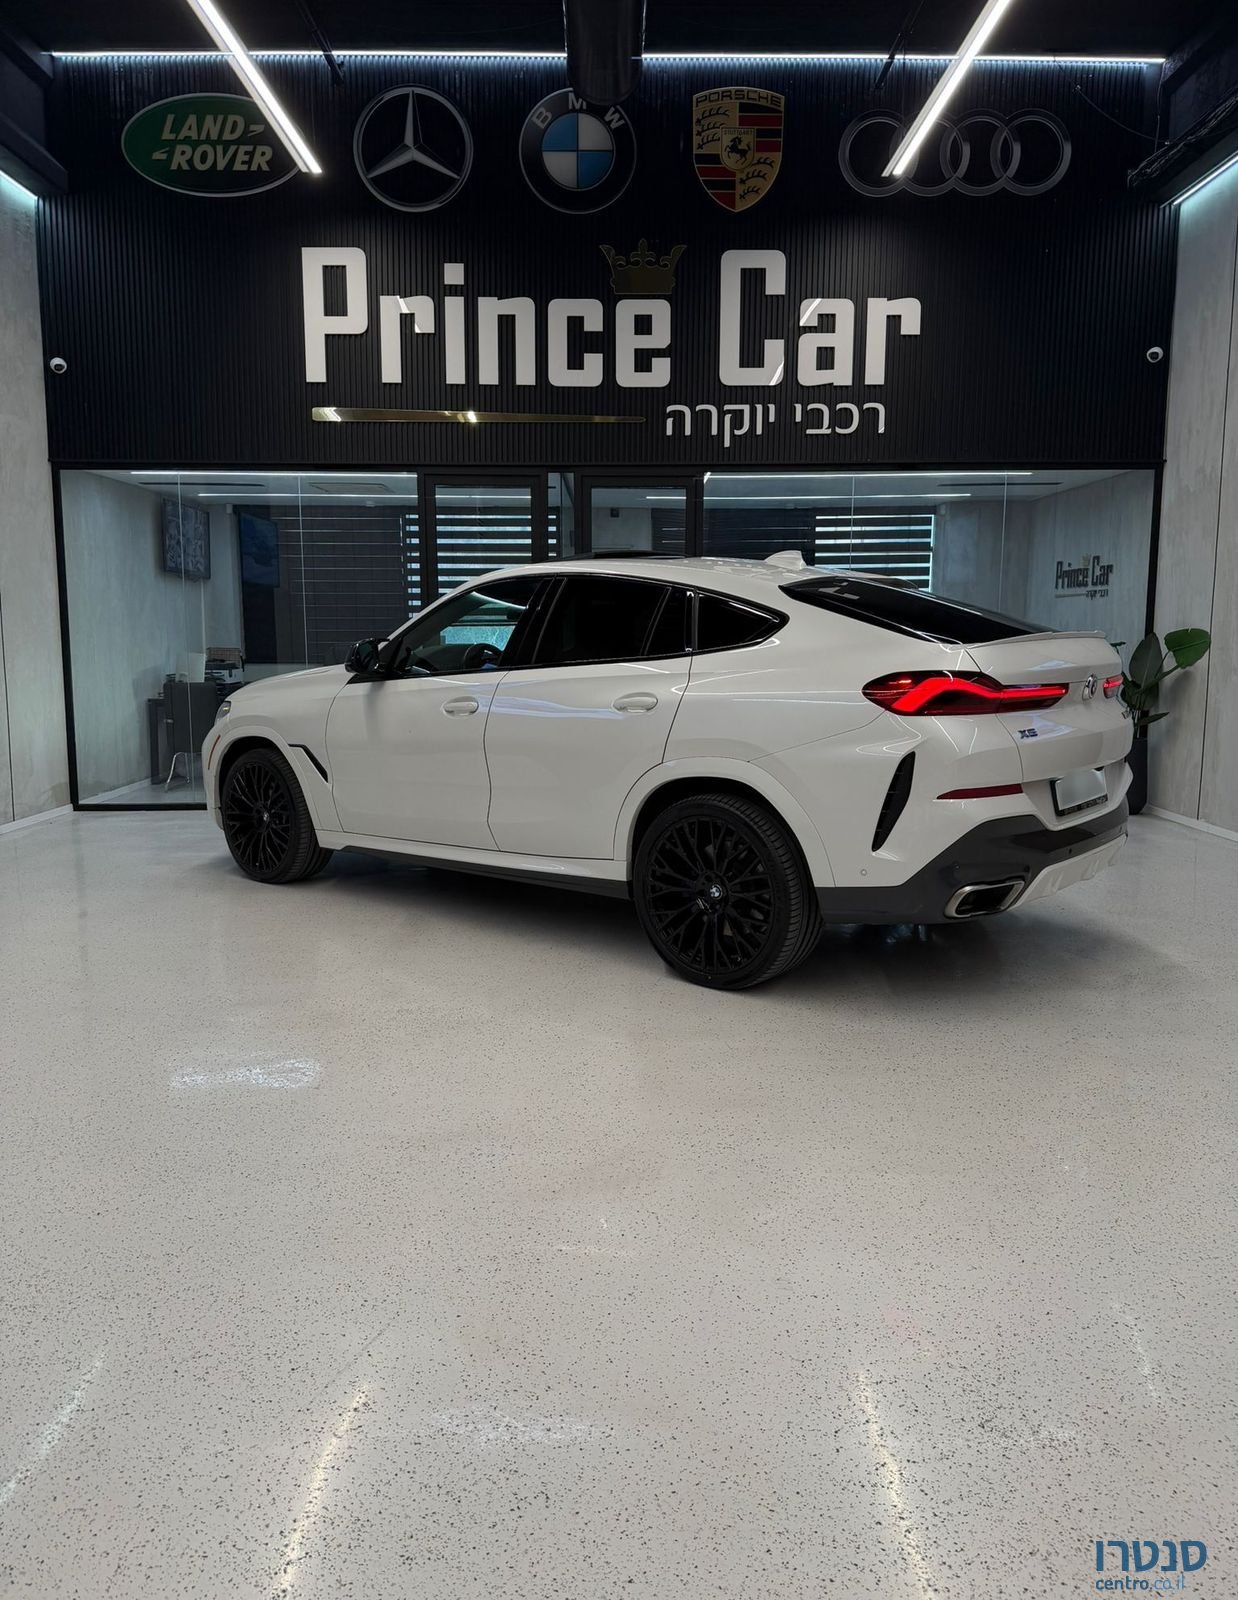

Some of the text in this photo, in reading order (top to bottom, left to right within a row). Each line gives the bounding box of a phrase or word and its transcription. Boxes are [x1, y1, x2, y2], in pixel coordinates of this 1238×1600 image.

[532, 92, 625, 129] BMW
[695, 89, 782, 108] PORSCHE
[161, 114, 246, 141] LAND
[170, 144, 273, 172] ROVER
[301, 247, 922, 388] Prince Car
[666, 402, 886, 448] רכבי יוקרה
[1055, 555, 1114, 590] Prince Car
